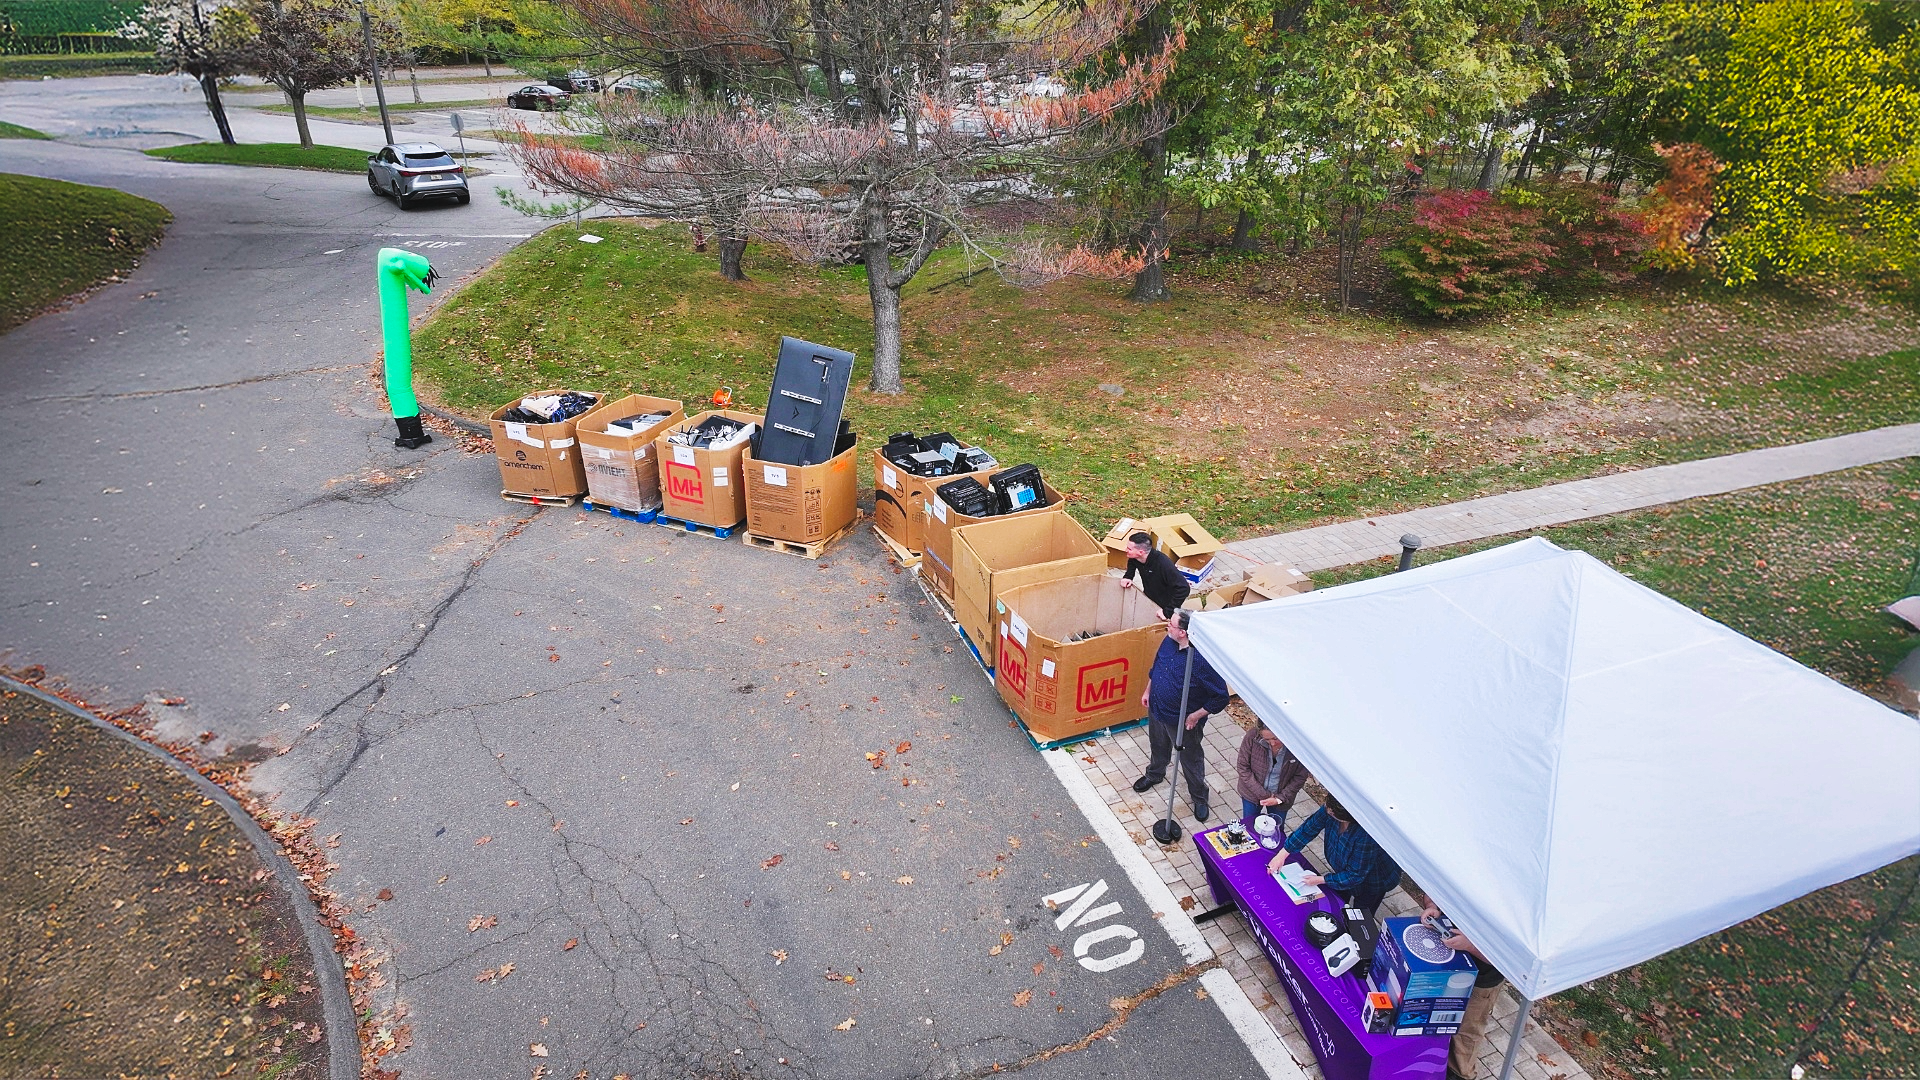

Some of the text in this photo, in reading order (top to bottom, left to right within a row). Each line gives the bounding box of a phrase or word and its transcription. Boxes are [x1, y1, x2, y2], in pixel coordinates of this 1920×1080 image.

[393, 240, 466, 248] STOP
[673, 476, 703, 499] MH
[1003, 650, 1027, 692] MH
[1085, 674, 1128, 704] MH
[1042, 879, 1145, 972] NO
[1222, 858, 1360, 1018] ww.thewalkergroup.com
